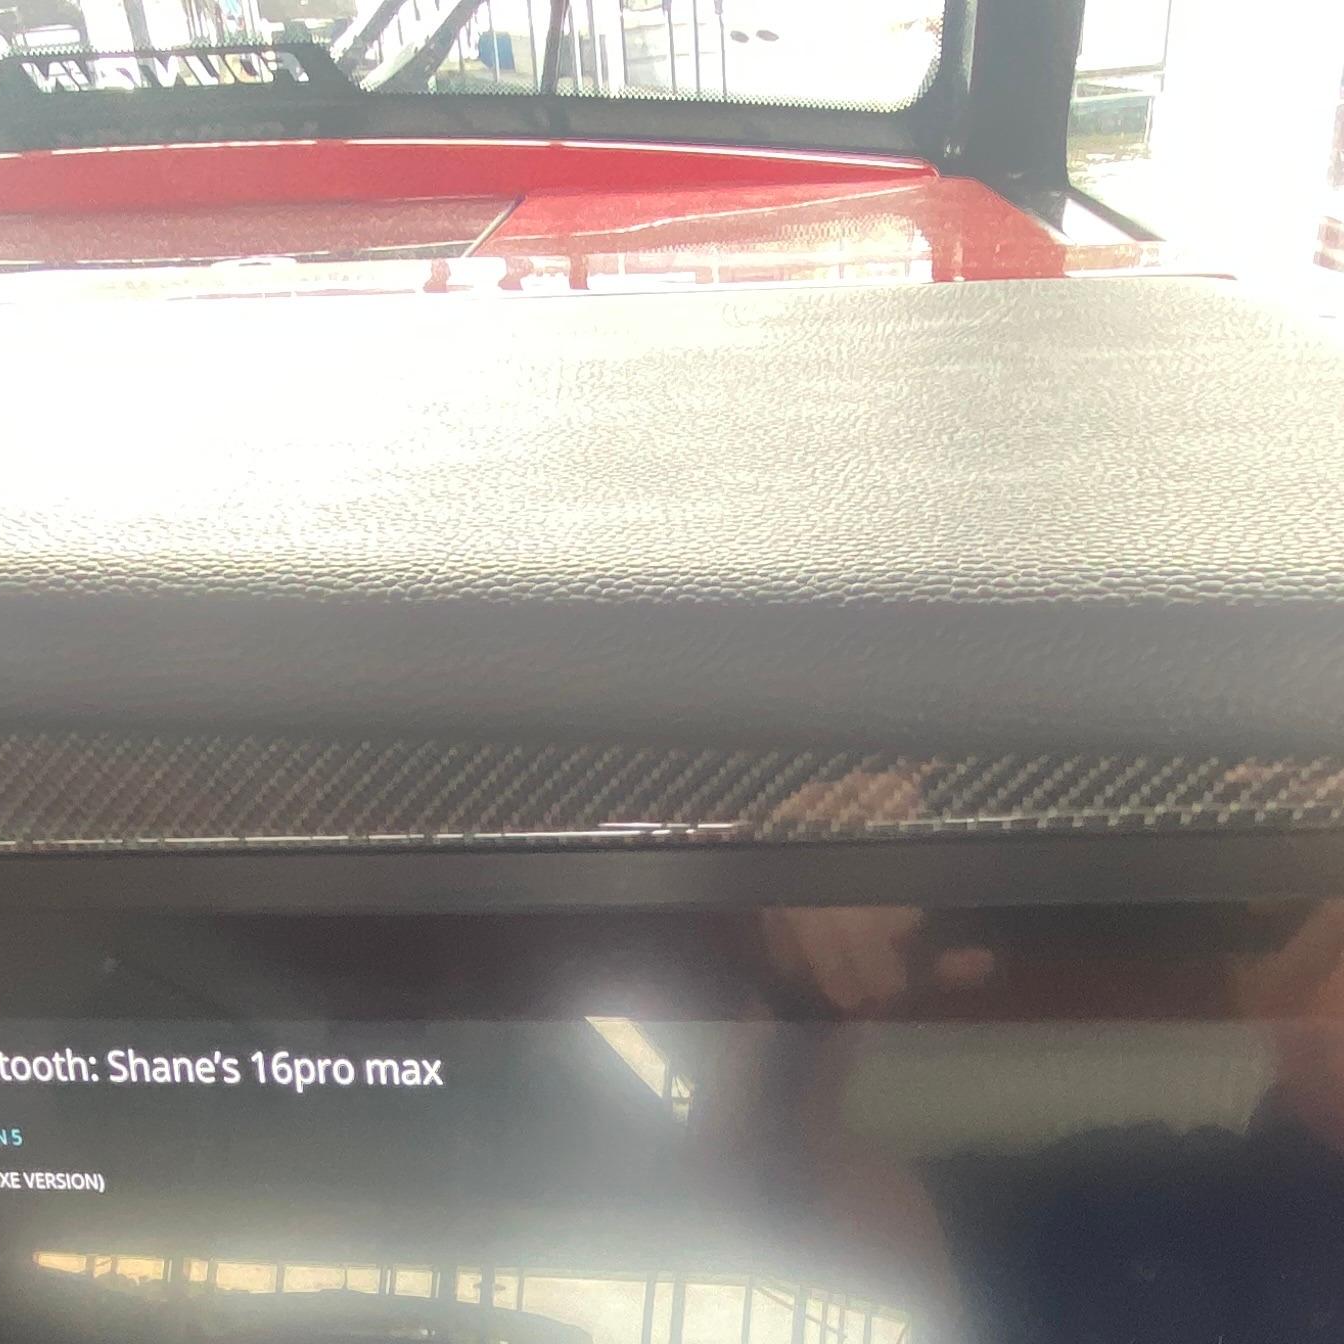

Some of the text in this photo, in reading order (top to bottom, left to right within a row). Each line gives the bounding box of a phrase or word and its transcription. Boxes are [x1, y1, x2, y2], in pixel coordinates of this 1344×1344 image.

[107, 1050, 240, 1084] Shane's
[252, 1051, 355, 1093] 16pro
[365, 1059, 444, 1087] max
[11, 1130, 23, 1146] 5
[24, 1172, 105, 1193] VERSION)
